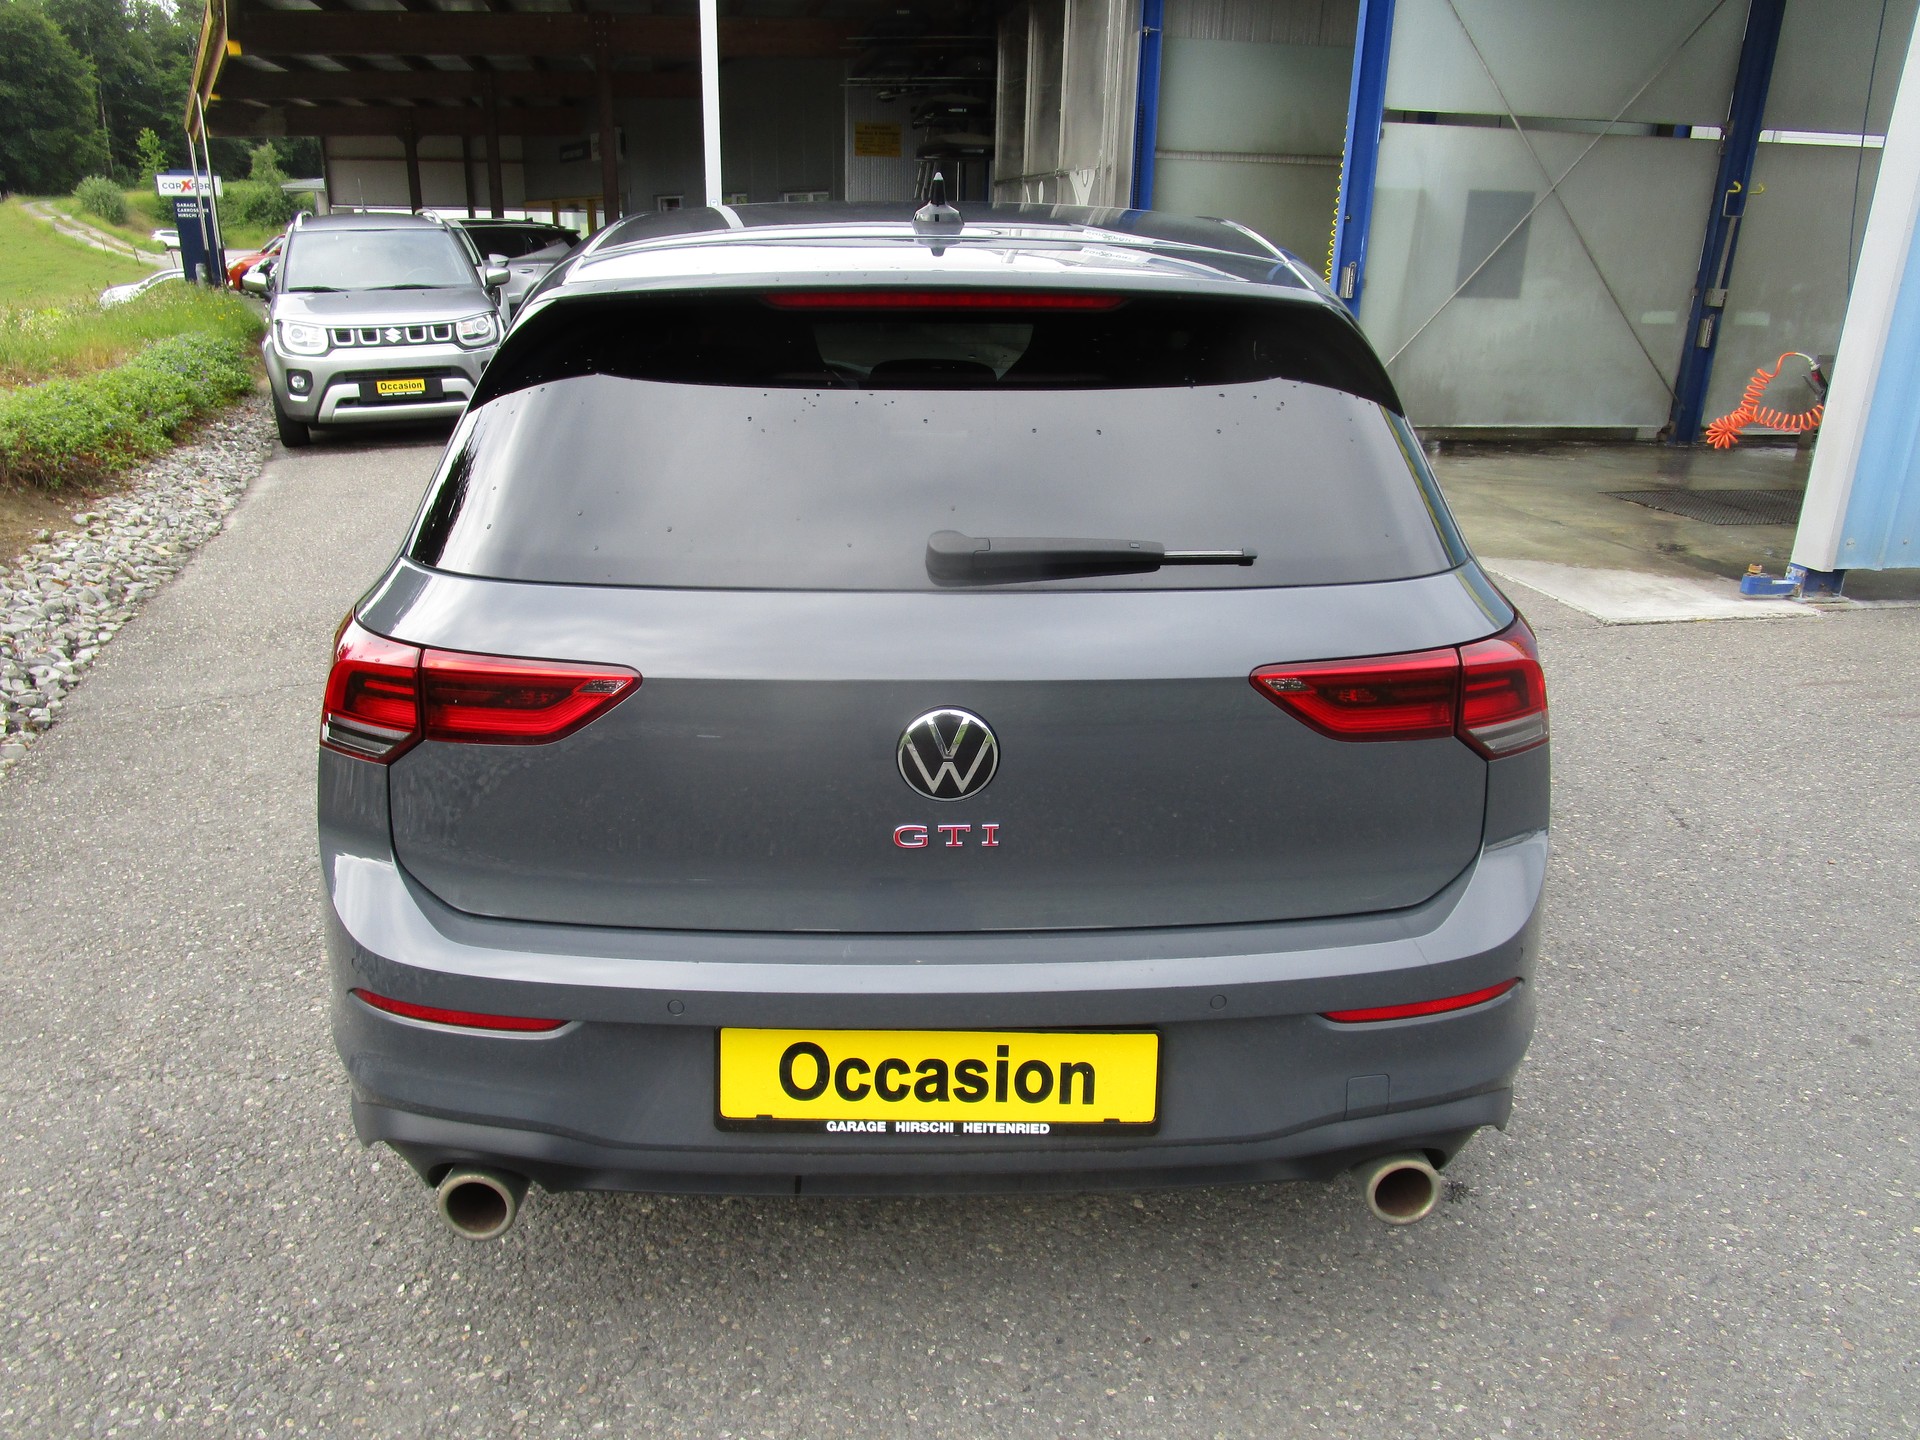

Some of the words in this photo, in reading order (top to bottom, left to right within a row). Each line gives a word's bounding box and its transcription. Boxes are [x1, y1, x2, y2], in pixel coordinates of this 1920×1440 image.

[380, 381, 422, 390] Occasion
[893, 824, 999, 849] GTI
[778, 1041, 1096, 1105] Occasion
[826, 1121, 887, 1132] GARAGE
[895, 1121, 954, 1133] HIRSCHI
[962, 1122, 1050, 1134] HEITENRIED
